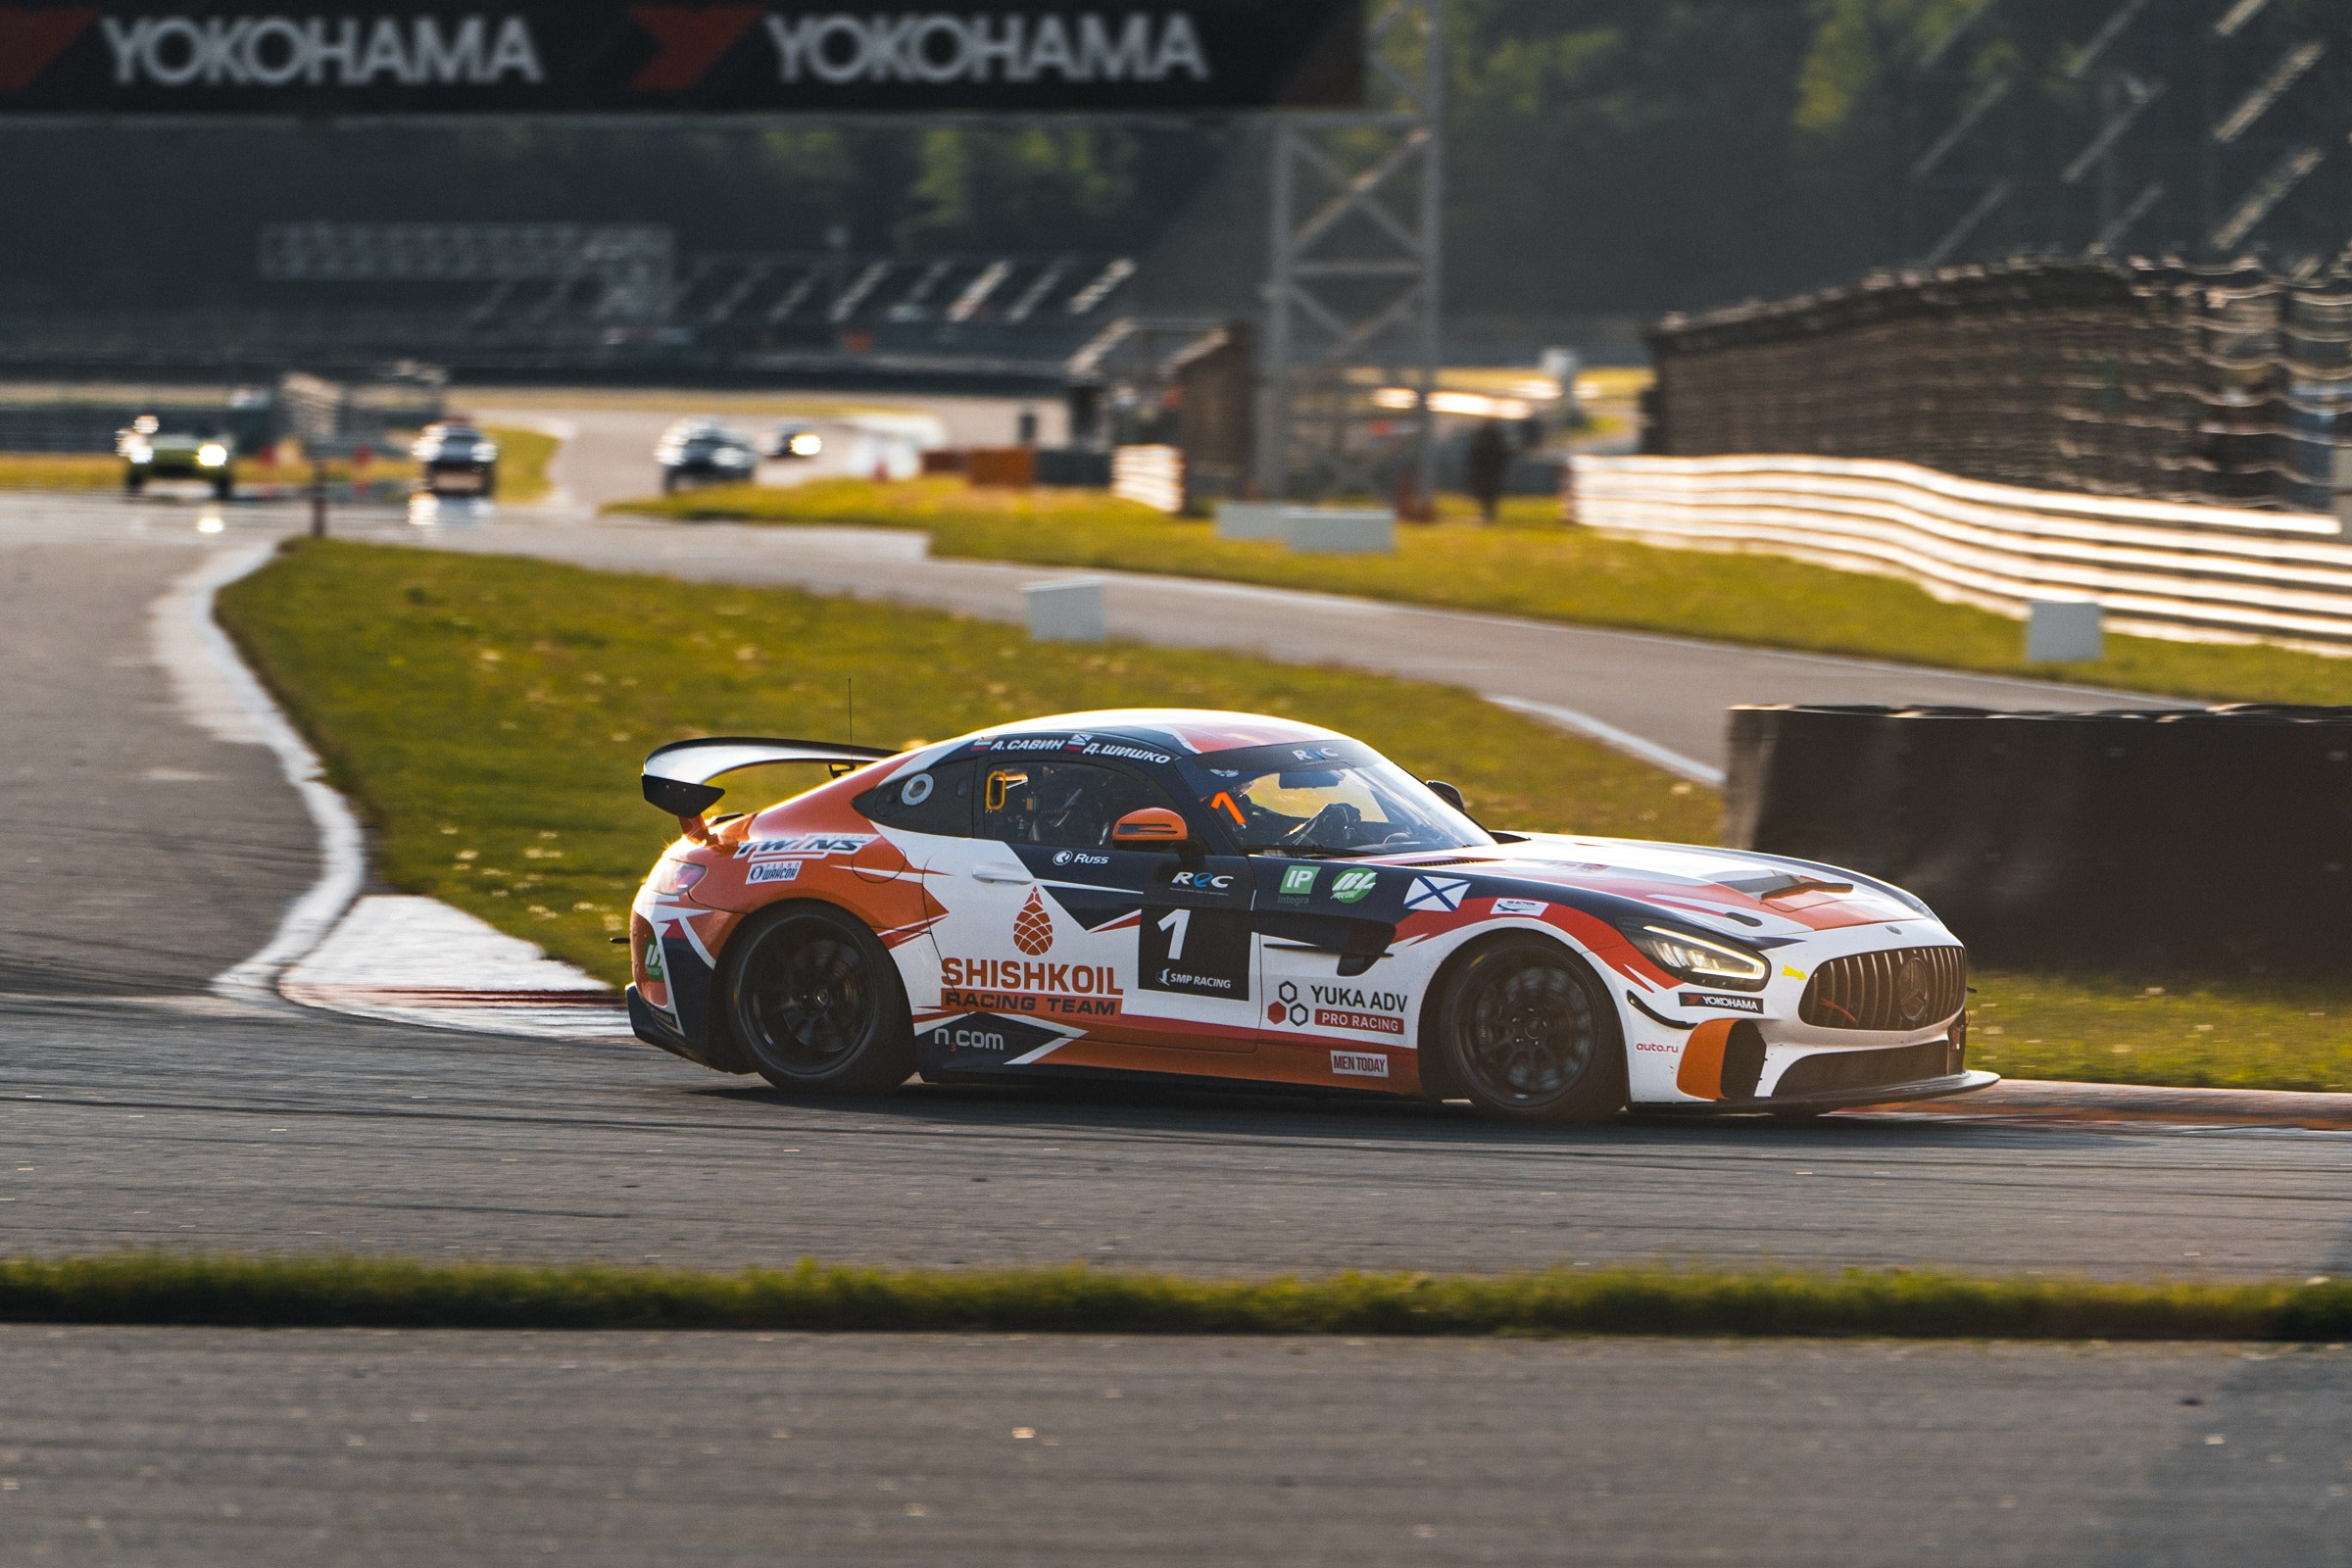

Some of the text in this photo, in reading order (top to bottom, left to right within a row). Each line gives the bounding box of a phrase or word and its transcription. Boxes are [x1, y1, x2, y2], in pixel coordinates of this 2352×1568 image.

[104, 18, 543, 84] YOKOHAMA
[764, 11, 1209, 81] YOKOHAMA
[1082, 742, 1171, 764] Д.ШИШКО
[1286, 870, 1313, 889] IP
[1277, 895, 1310, 906] integra
[1157, 908, 1192, 960] 1
[941, 956, 1124, 996] SHISHKOIL
[1170, 973, 1232, 989] SMP RACING
[945, 991, 1116, 1016] RACING TEAM
[1310, 985, 1408, 1013] YUKA ADV
[1701, 996, 1759, 1011] YOKOHAMA
[1321, 1012, 1398, 1032] PRO RACING
[1636, 1043, 1679, 1054] auto.ru
[1333, 1054, 1386, 1073] MEN TODAY
